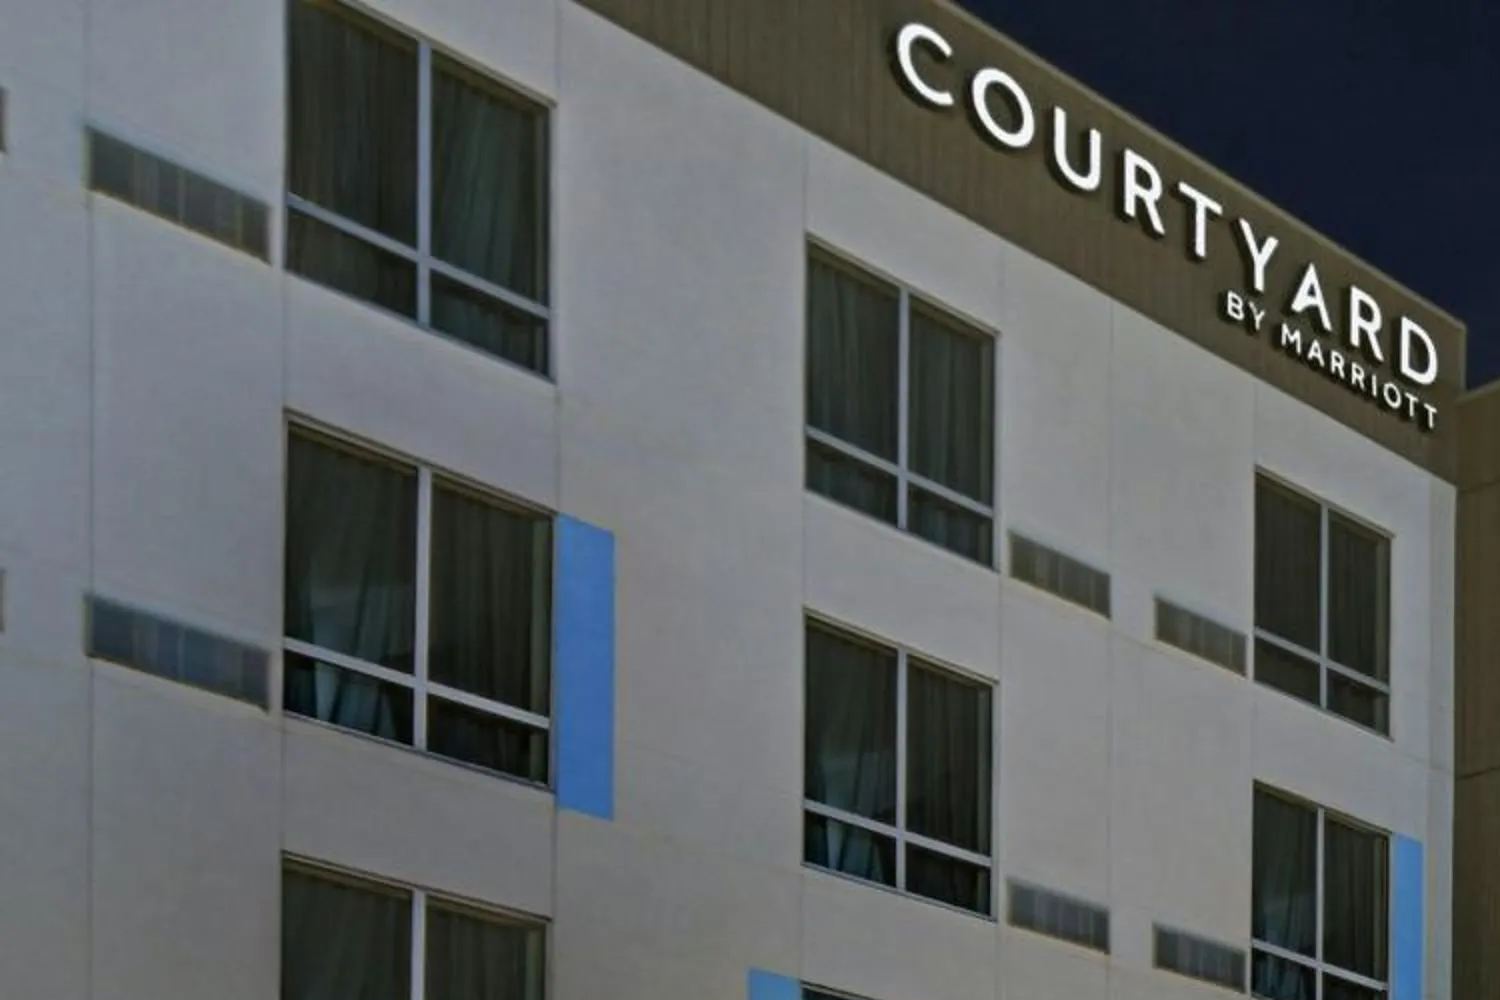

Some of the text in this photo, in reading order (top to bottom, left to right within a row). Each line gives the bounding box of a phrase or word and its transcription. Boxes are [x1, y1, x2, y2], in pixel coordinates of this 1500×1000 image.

[897, 22, 1438, 386] COURTYARD
[1227, 291, 1438, 428] BY MARRIOTT
